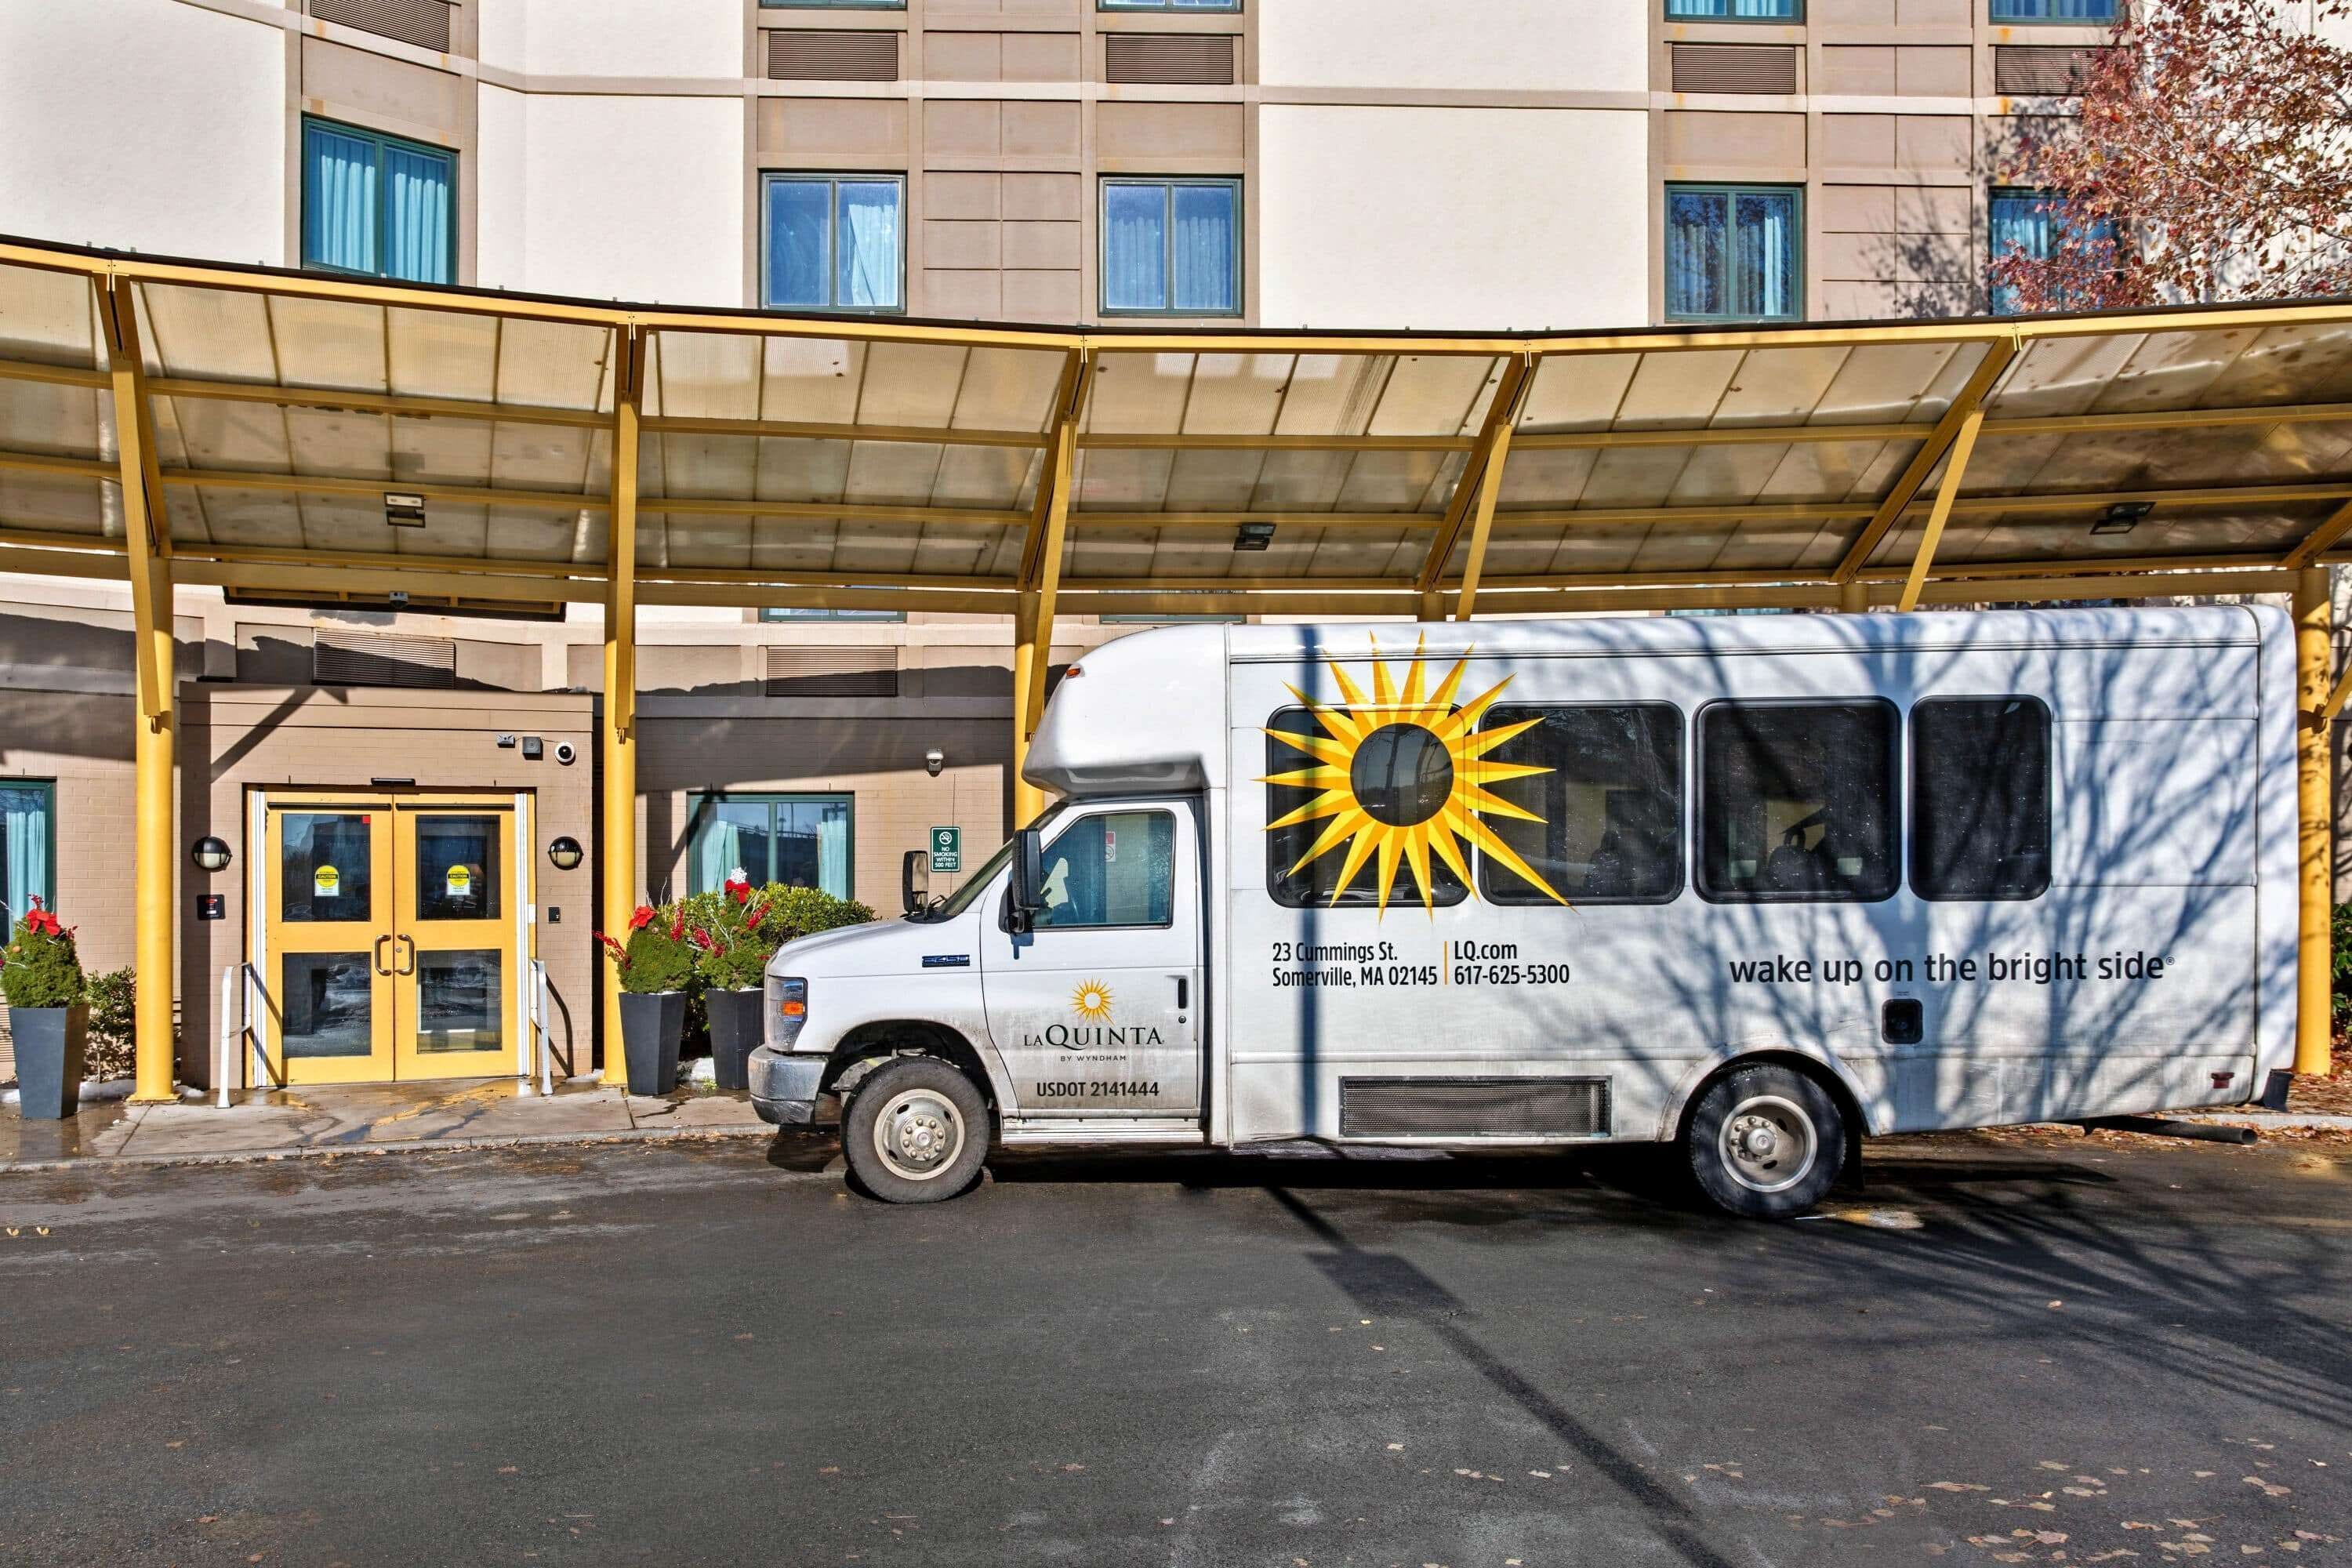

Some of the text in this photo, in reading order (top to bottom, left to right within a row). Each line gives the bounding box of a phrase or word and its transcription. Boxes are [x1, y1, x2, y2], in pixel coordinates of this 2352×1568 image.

[1272, 941, 1398, 964] 23 Cummings St.
[1454, 940, 1518, 961] LQ.com
[1272, 966, 1438, 989] Somerville, MA 02145
[1454, 964, 1570, 985] 617-625-5300
[1729, 954, 1812, 983] wake
[1823, 959, 1864, 986] up
[1874, 957, 1914, 982] on
[1924, 953, 1977, 982] the
[1988, 952, 2088, 985] bright
[1036, 1081, 1160, 1097] USDOT 2141444
